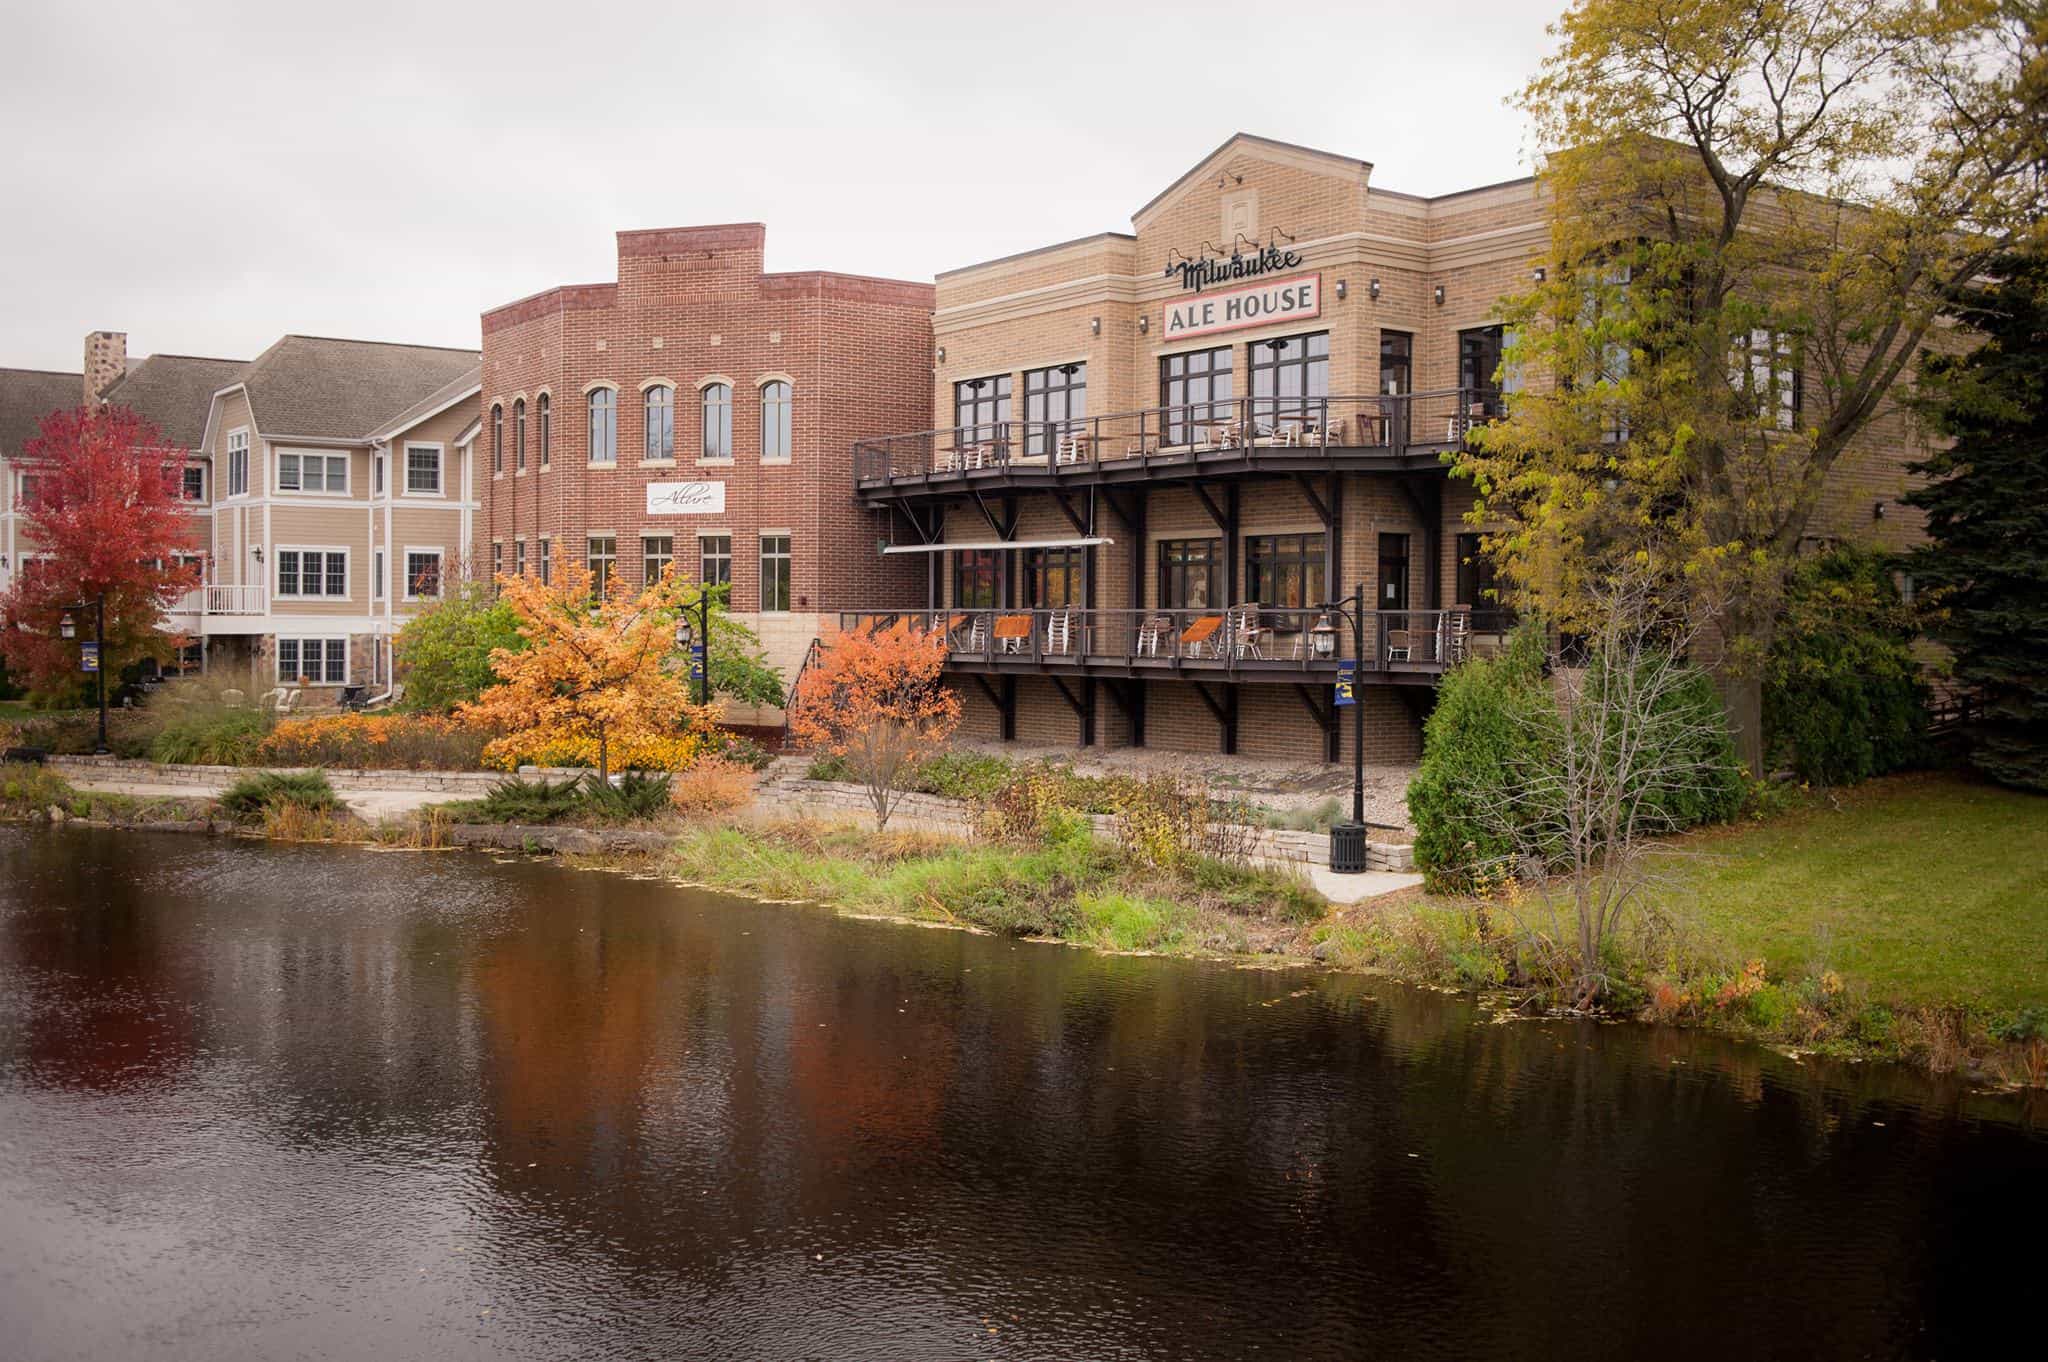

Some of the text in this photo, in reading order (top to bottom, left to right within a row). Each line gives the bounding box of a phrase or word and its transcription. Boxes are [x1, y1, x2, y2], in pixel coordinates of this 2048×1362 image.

[1174, 248, 1302, 292] Milwaukee
[1169, 285, 1312, 332] ALE HOUSE
